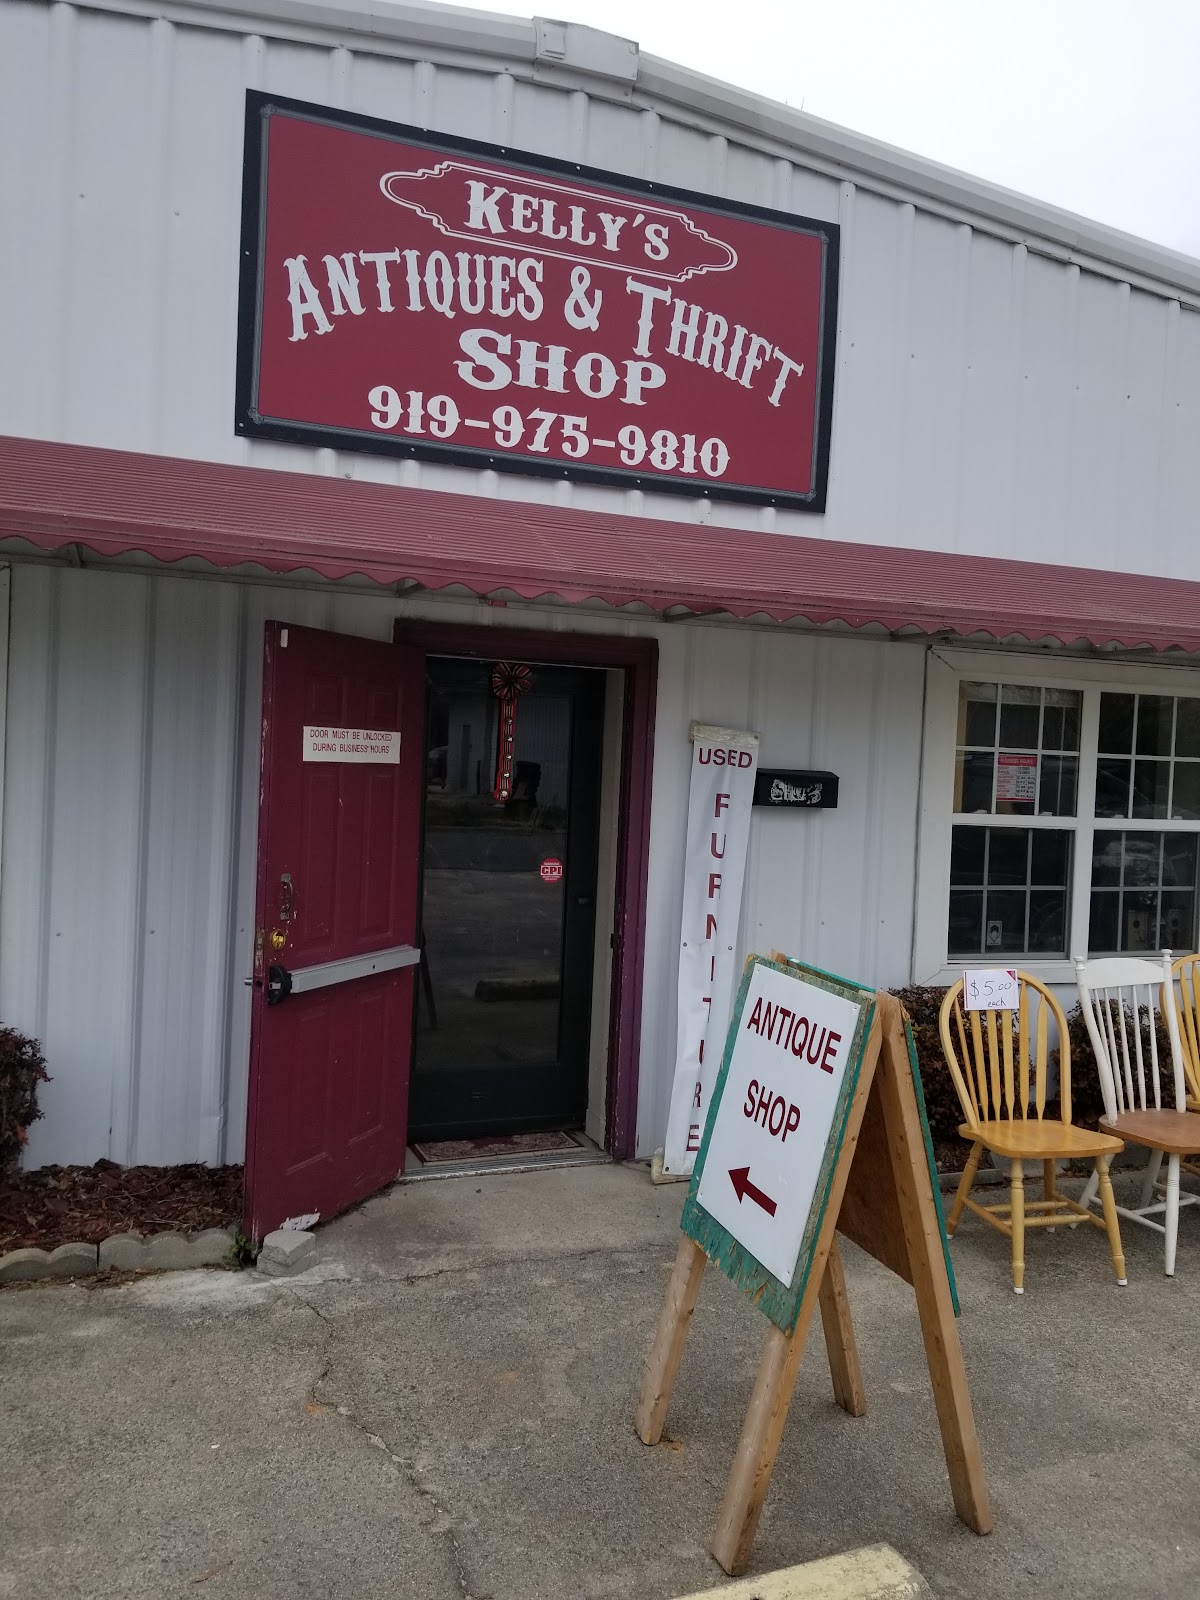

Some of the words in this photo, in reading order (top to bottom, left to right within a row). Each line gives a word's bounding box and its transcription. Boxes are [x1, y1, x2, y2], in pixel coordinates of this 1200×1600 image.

[463, 179, 670, 262] KELLY'S
[283, 247, 544, 342] ANTIQUES
[564, 265, 602, 332] &
[626, 276, 804, 407] THRIFT
[453, 328, 666, 405] SHOP
[367, 385, 730, 477] 919-975-9810
[310, 729, 328, 738] DOOR
[332, 730, 349, 740] MUST
[352, 731, 360, 740] BE
[363, 732, 392, 741] UNLOCKED
[313, 742, 336, 752] DURING
[340, 743, 368, 753] BUSINESS
[371, 745, 389, 754] HOURS
[698, 748, 753, 768] USED
[541, 867, 562, 875] CPI
[988, 997, 1006, 1007] each
[746, 996, 842, 1075] ANTIQUE
[743, 1079, 801, 1143] SHOP
